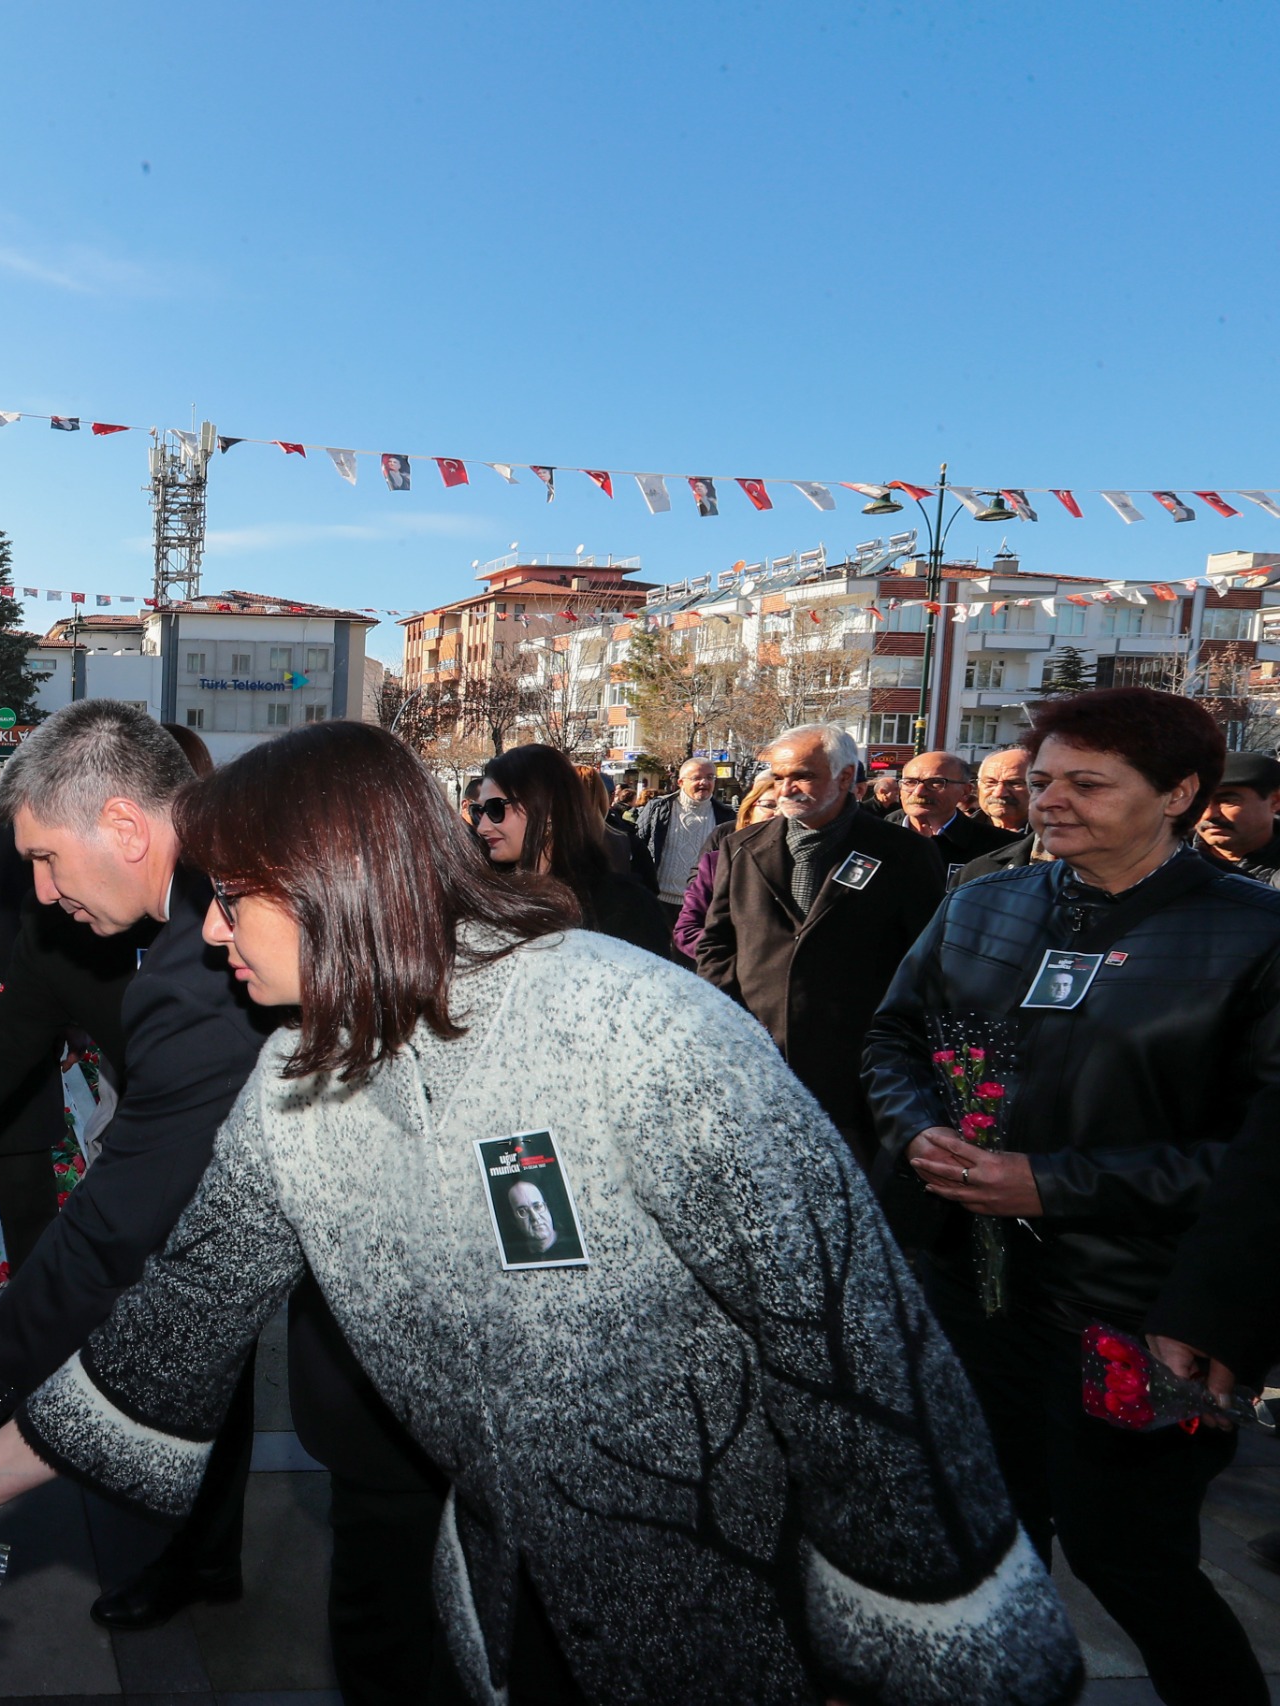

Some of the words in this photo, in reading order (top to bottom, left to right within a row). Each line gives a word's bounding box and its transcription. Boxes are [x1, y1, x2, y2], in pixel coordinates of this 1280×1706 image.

[200, 678, 228, 690] Türk
[232, 679, 285, 691] Telekom
[499, 1151, 517, 1166] uğur
[489, 1163, 521, 1177] mumcu
